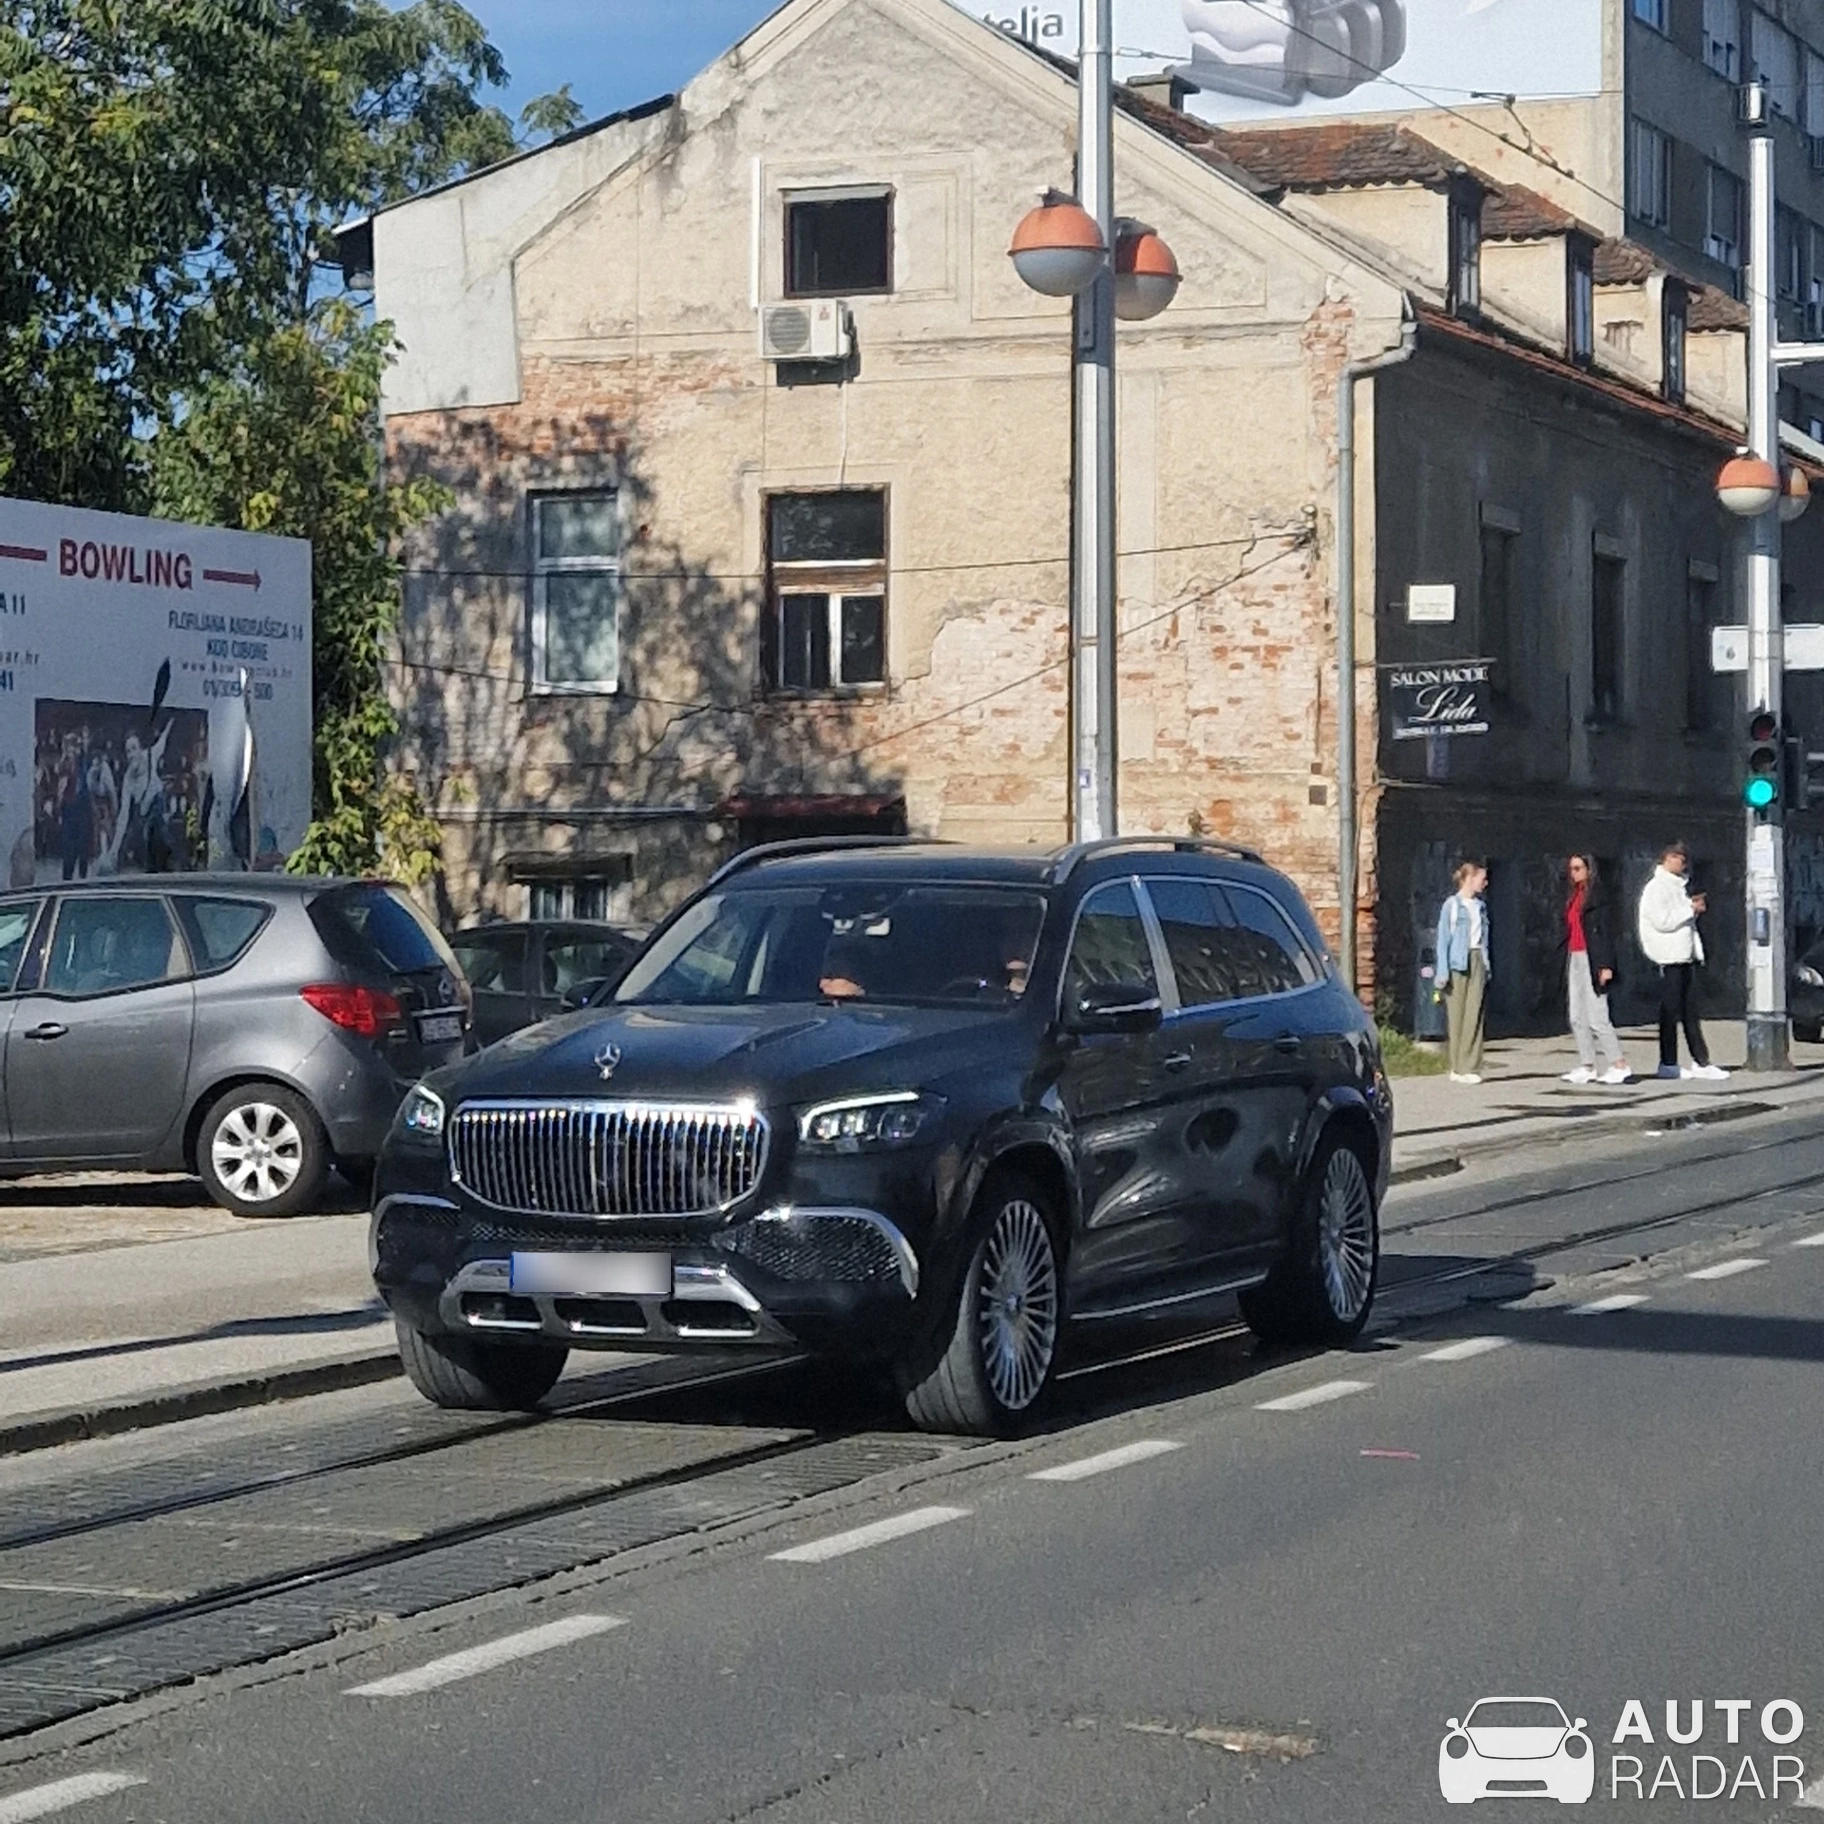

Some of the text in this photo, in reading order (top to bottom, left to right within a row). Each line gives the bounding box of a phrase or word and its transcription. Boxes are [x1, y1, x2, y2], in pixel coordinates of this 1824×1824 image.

[59, 537, 193, 590] BOWLING
[1390, 666, 1489, 687] SALON MODE
[1408, 686, 1478, 723] Lida
